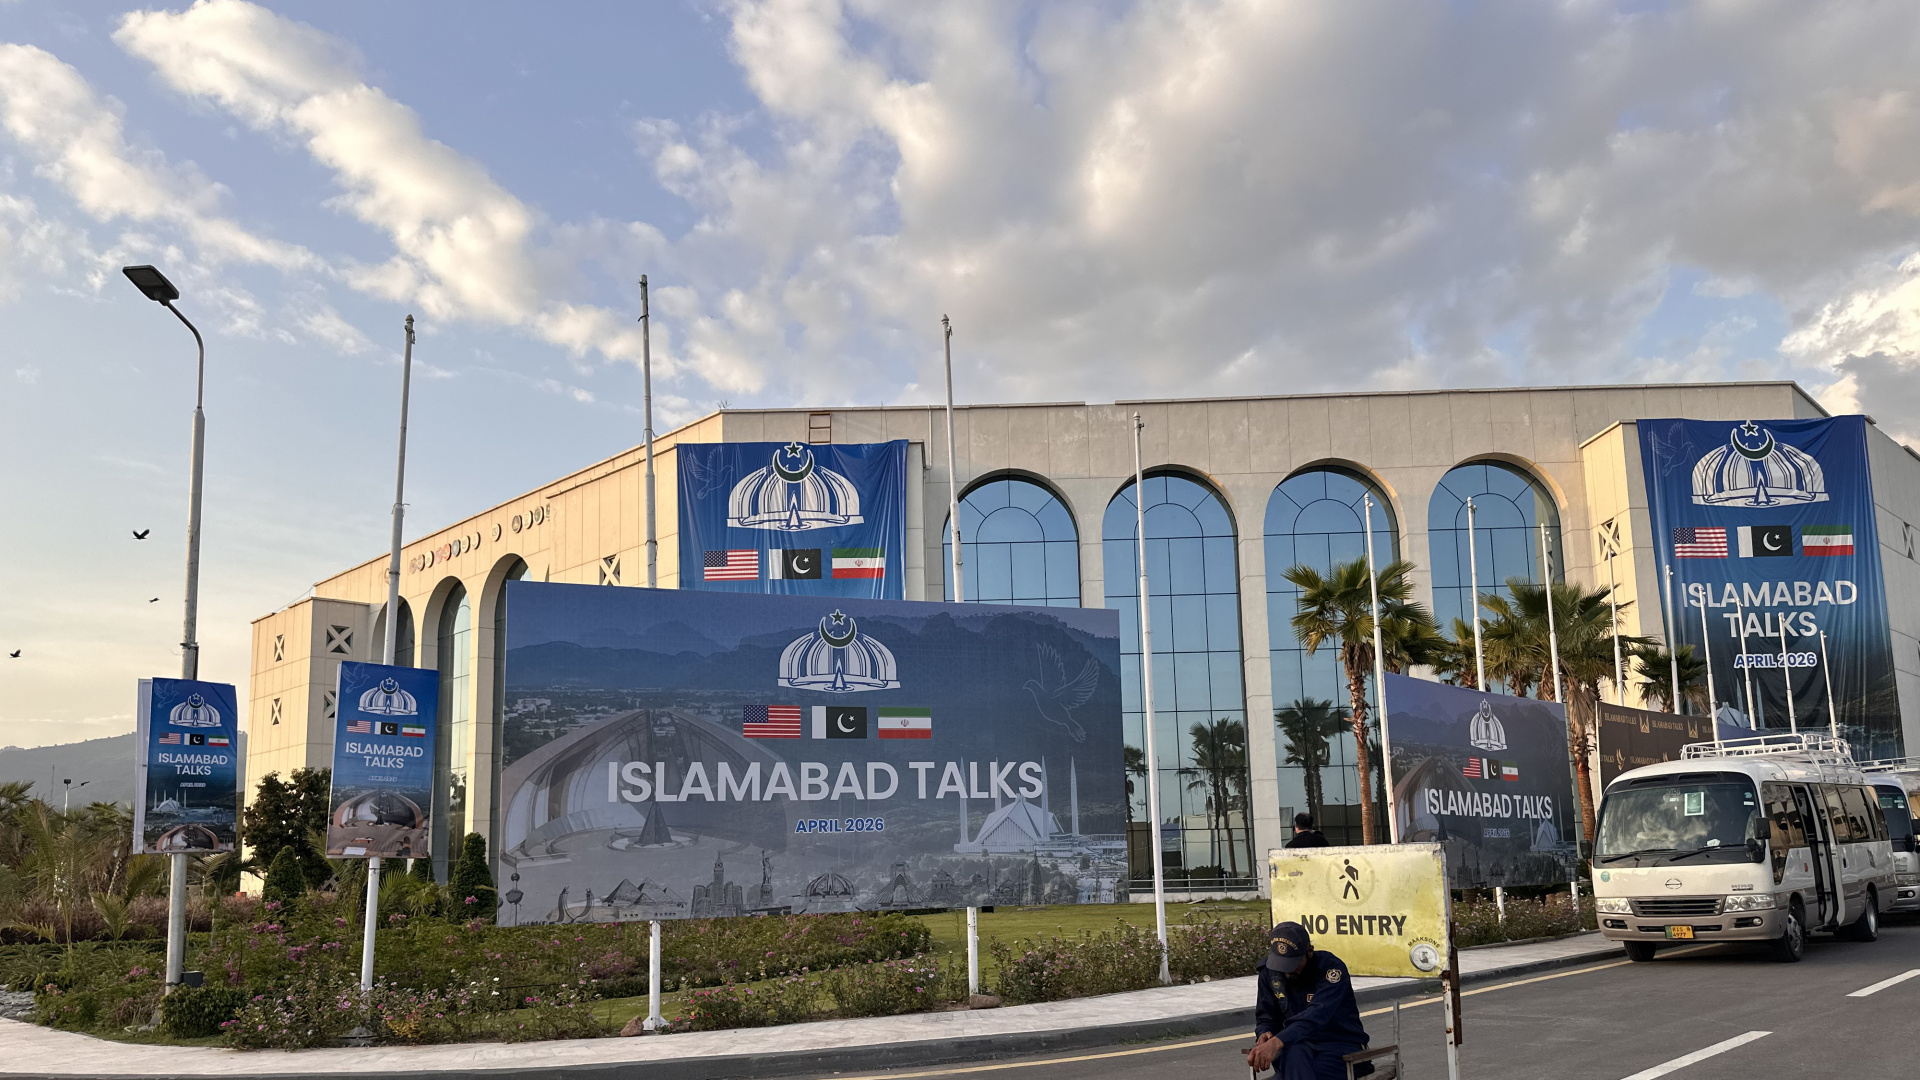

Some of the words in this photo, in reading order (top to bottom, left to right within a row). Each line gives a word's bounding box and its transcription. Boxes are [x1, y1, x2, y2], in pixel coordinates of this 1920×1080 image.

[1681, 580, 1857, 608] ISLAMABAD
[1722, 612, 1818, 638] TALKS
[1734, 653, 1777, 669] APRIL
[1777, 652, 1817, 668] 2026
[158, 752, 228, 765] ISLAMABAD
[345, 742, 423, 758] ISLAMABAD
[175, 764, 211, 776] TALKS
[363, 755, 404, 769] TALKS
[607, 761, 898, 803] ISLAMABAD
[909, 760, 1043, 801] TALKS
[1424, 788, 1511, 818] ISLAMABAD
[1514, 795, 1552, 819] TALKS
[795, 818, 842, 833] APRIL
[845, 817, 885, 832] 2026
[1301, 914, 1329, 935] NO
[1336, 915, 1407, 936] ENTRY
